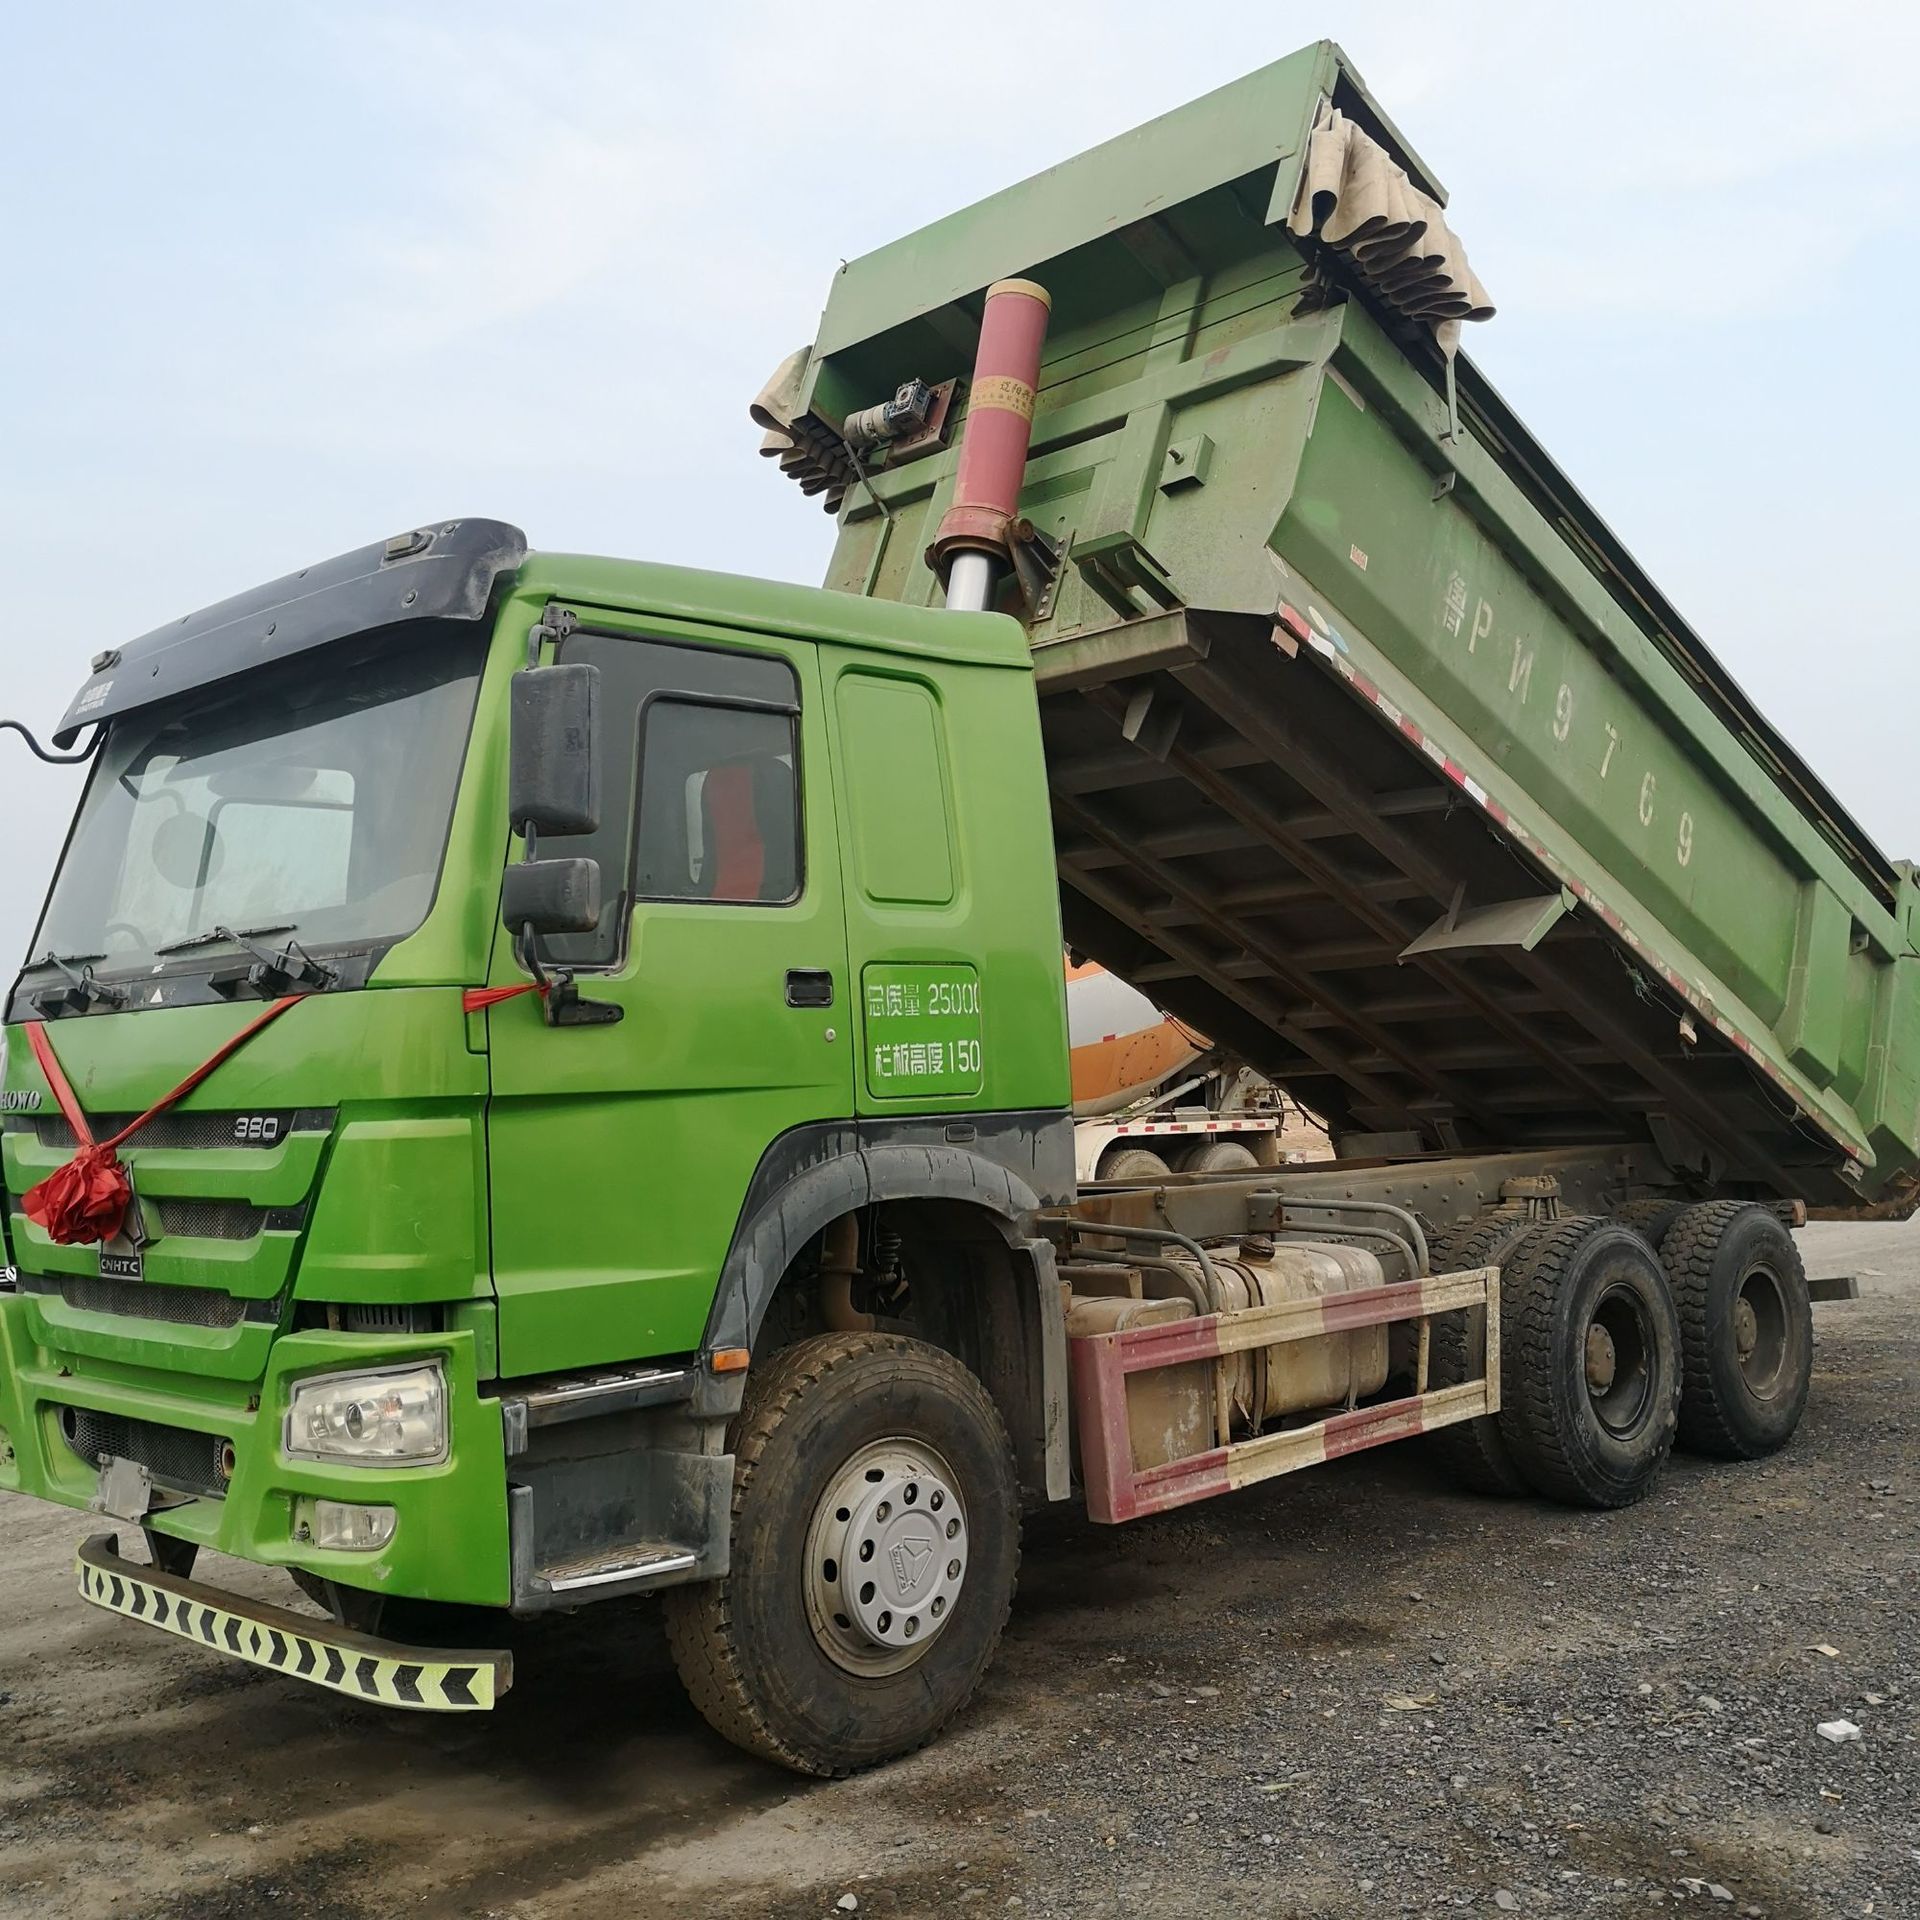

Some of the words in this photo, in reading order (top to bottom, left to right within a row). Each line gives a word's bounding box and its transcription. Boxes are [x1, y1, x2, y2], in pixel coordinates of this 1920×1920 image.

[875, 1041, 943, 1077] 栏板高度
[948, 1040, 981, 1073] 150
[235, 1117, 278, 1139] 380
[100, 1258, 139, 1274] CNHTC
